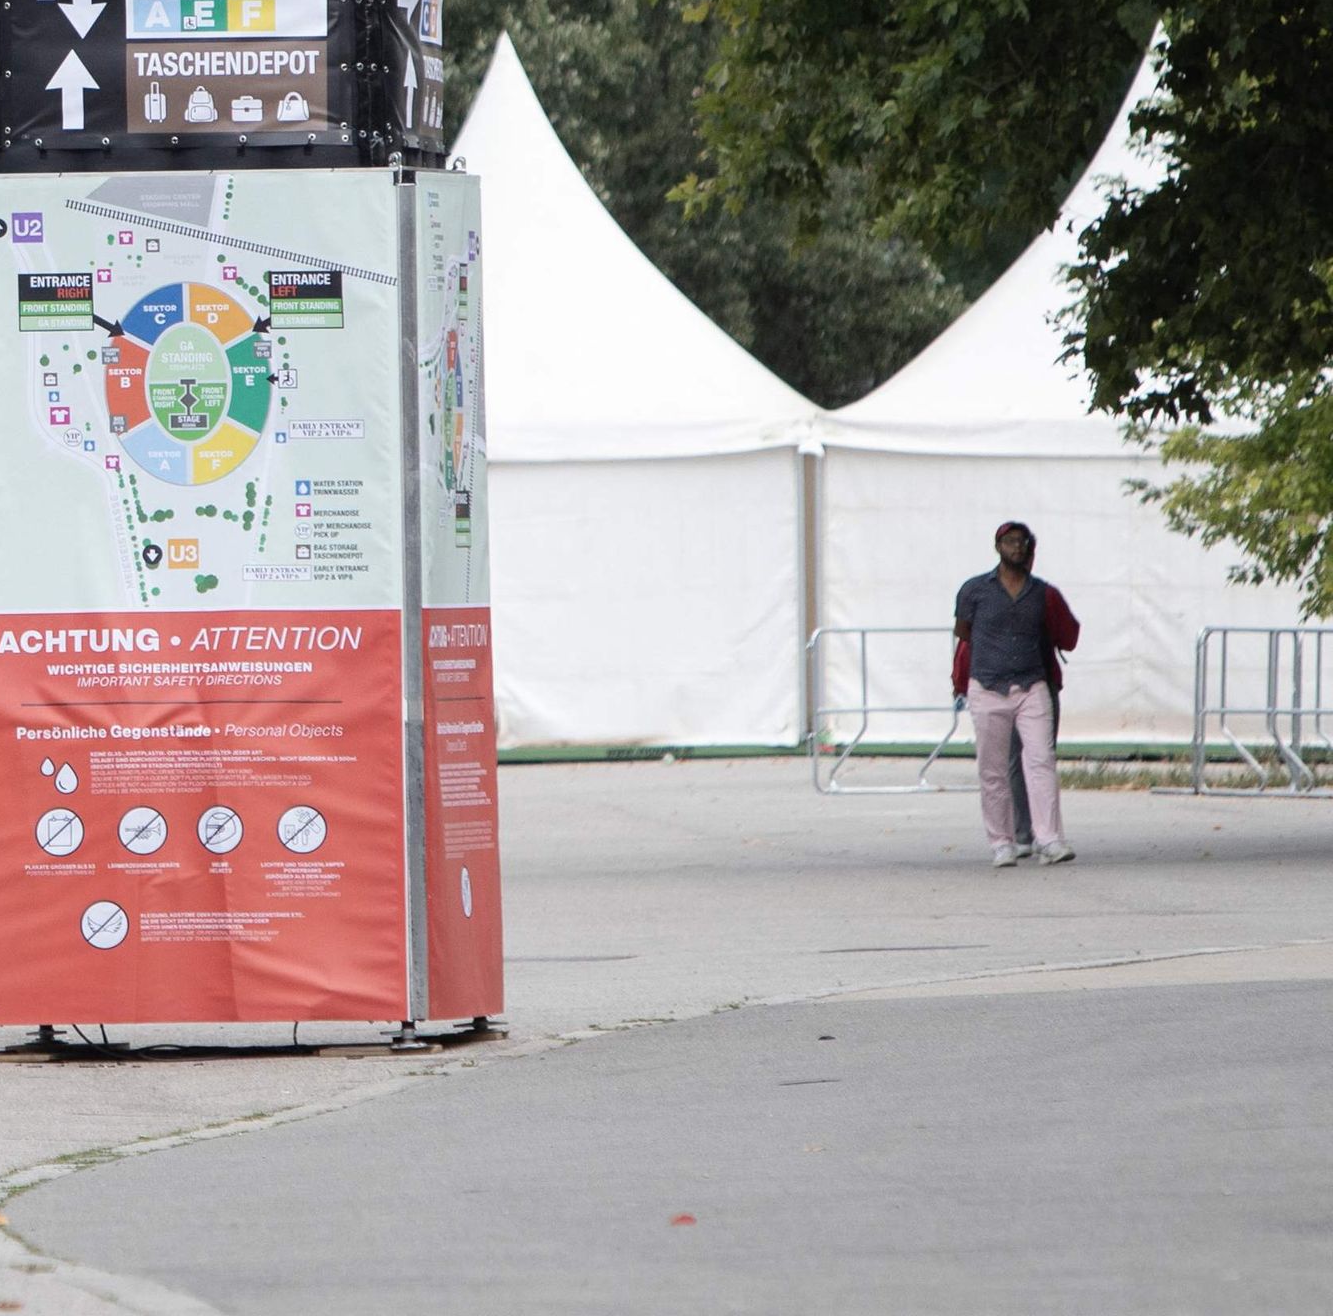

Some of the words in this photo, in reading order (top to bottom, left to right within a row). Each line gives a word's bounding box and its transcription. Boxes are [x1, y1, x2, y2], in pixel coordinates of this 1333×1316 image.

[144, 1, 171, 29] A
[196, 0, 215, 27] E
[242, 0, 261, 26] F
[134, 51, 320, 77] TASCHENDEPOT
[14, 219, 42, 237] U2
[30, 275, 90, 288] ENTRANCE
[271, 273, 331, 286] ENTRANCE
[57, 288, 90, 299] RIGHT
[272, 286, 298, 297] LEFT
[23, 304, 49, 313] FRONT
[50, 303, 90, 312] STANDING
[195, 304, 230, 312] SEKTOR
[272, 302, 299, 310] FRONT
[301, 301, 339, 310] STANDING
[154, 313, 166, 324] C
[207, 312, 218, 324] D
[287, 316, 325, 325] STANDING
[180, 341, 195, 351] GA
[161, 352, 213, 364] STANDING
[121, 377, 131, 388] B
[245, 375, 254, 386] E
[177, 415, 201, 423] STAGE
[159, 460, 171, 470] A
[211, 460, 221, 470] F
[170, 545, 198, 563] U3
[190, 626, 362, 652] ATTENTION
[47, 664, 116, 676] WICHTIGE
[119, 662, 313, 674] SICHERHEITSANWEISUNGEN
[77, 675, 150, 688] IMPORTANT
[153, 674, 204, 687] SAFETY
[206, 674, 282, 686] DIRECTIONS
[16, 725, 107, 740] Persönliche
[110, 724, 211, 740] Gegenstände
[224, 723, 290, 738] Personal
[293, 723, 344, 739] Objects
